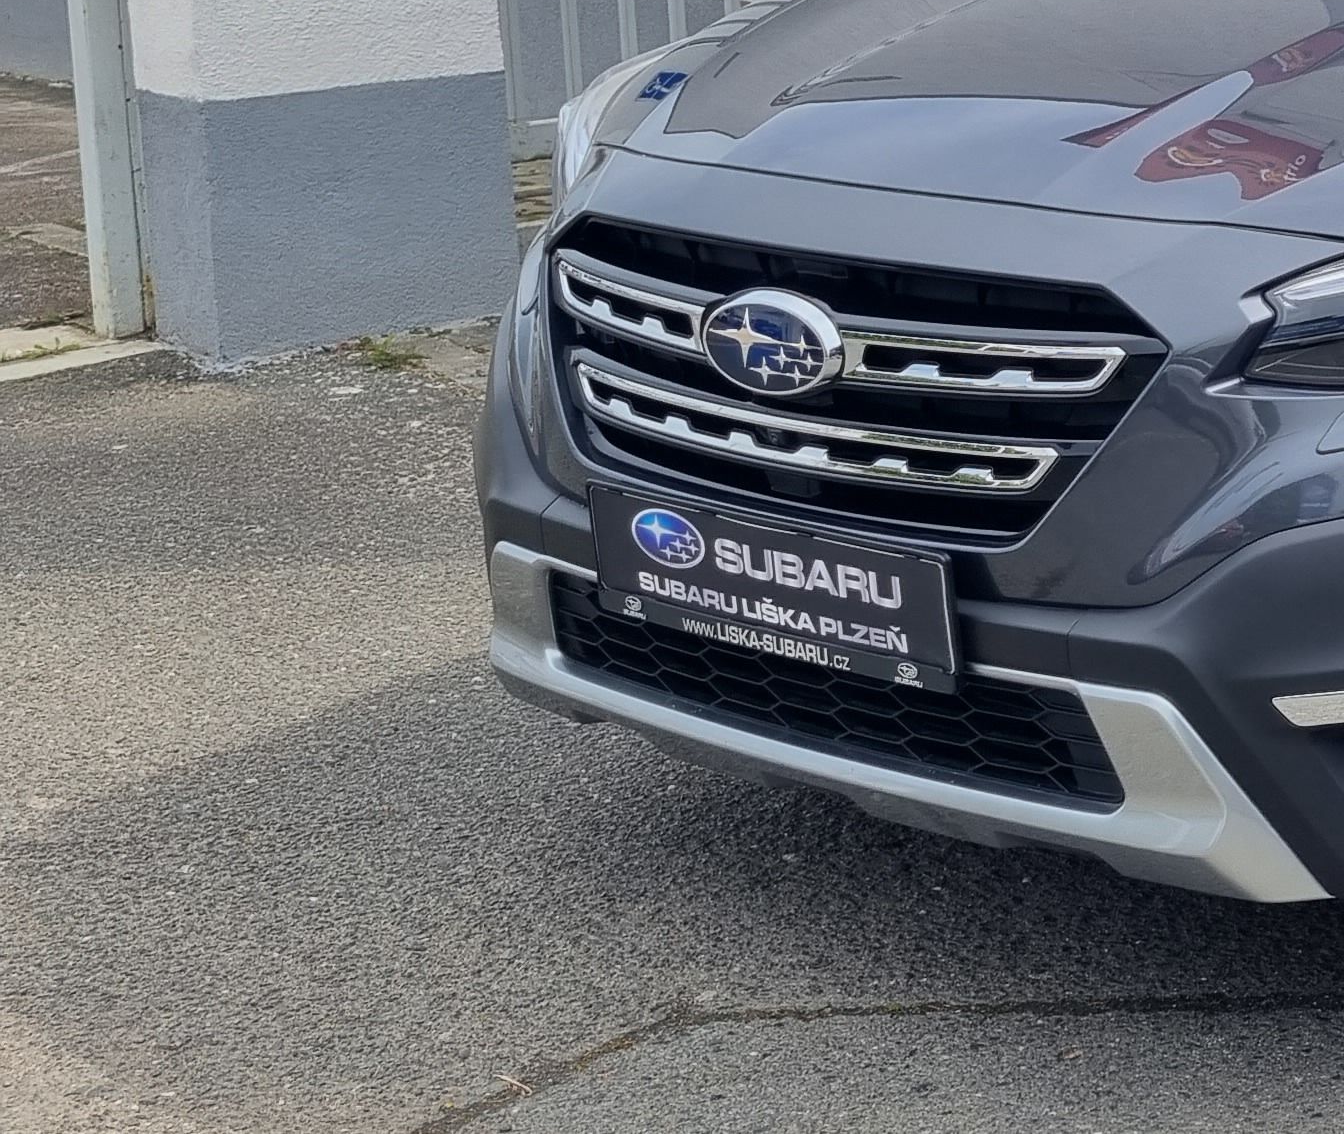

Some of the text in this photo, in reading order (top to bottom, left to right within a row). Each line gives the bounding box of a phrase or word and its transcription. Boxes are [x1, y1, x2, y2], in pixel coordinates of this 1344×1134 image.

[638, 571, 908, 655] SUBARU LIŠKA PLZEŇ
[714, 538, 902, 610] SUBARU
